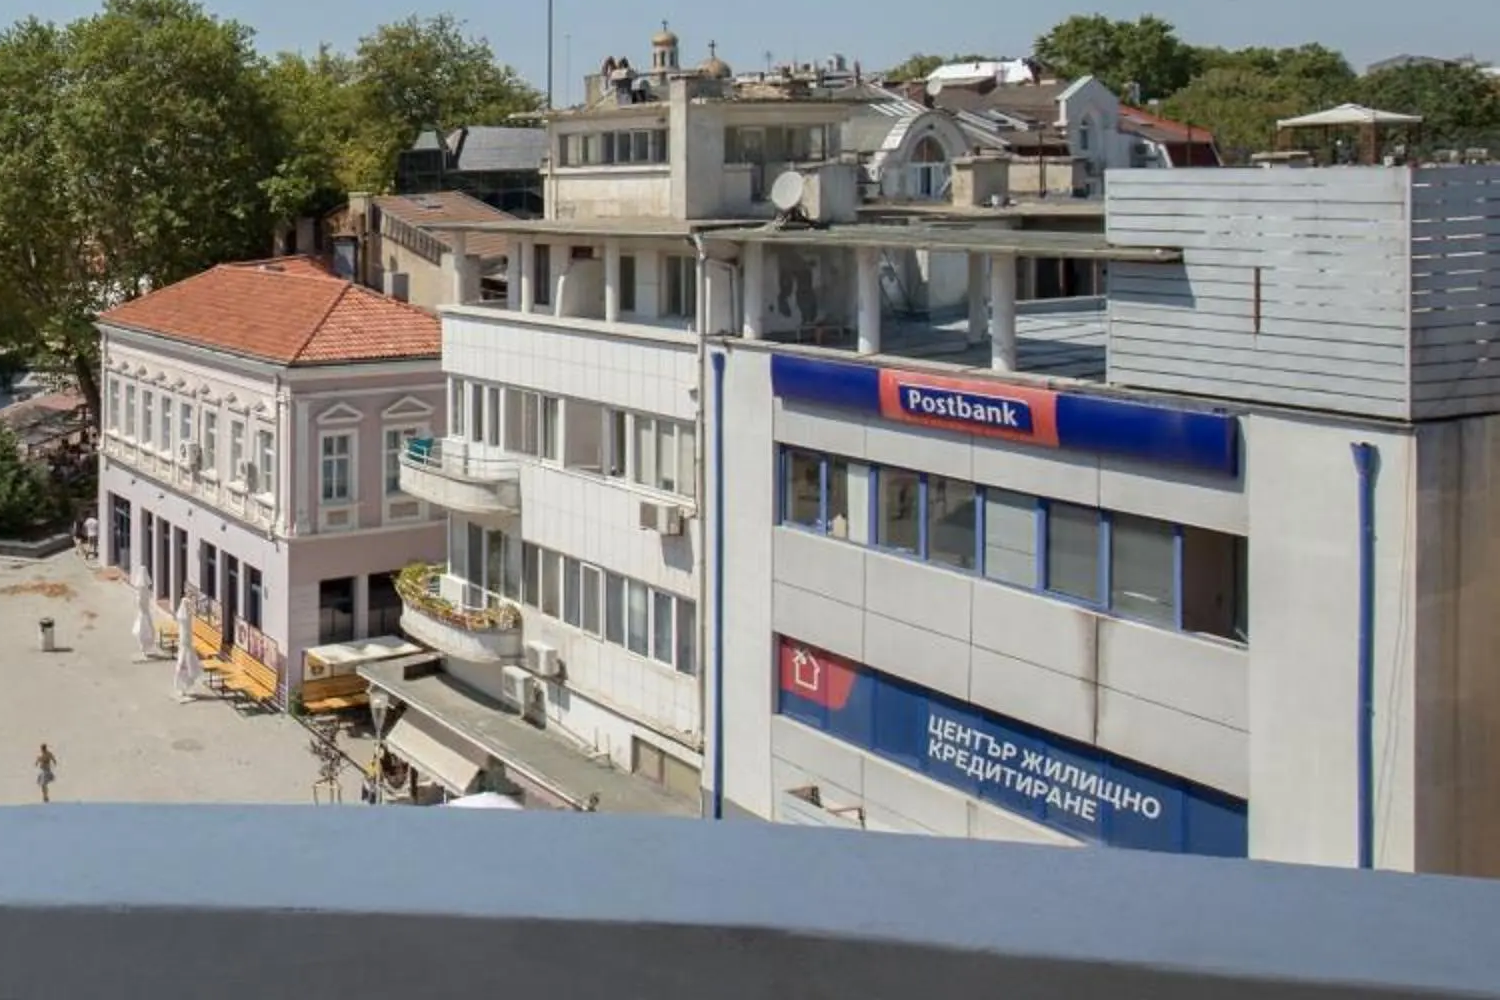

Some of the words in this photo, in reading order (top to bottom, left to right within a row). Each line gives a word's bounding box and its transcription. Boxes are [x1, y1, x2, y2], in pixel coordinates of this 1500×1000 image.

[908, 388, 1018, 428] Postbank
[928, 714, 1016, 761] ЦЕНТЪР
[1021, 750, 1162, 820] ЖИЛИЩНО
[928, 738, 1098, 822] КРЕДИТИРАНЕ
